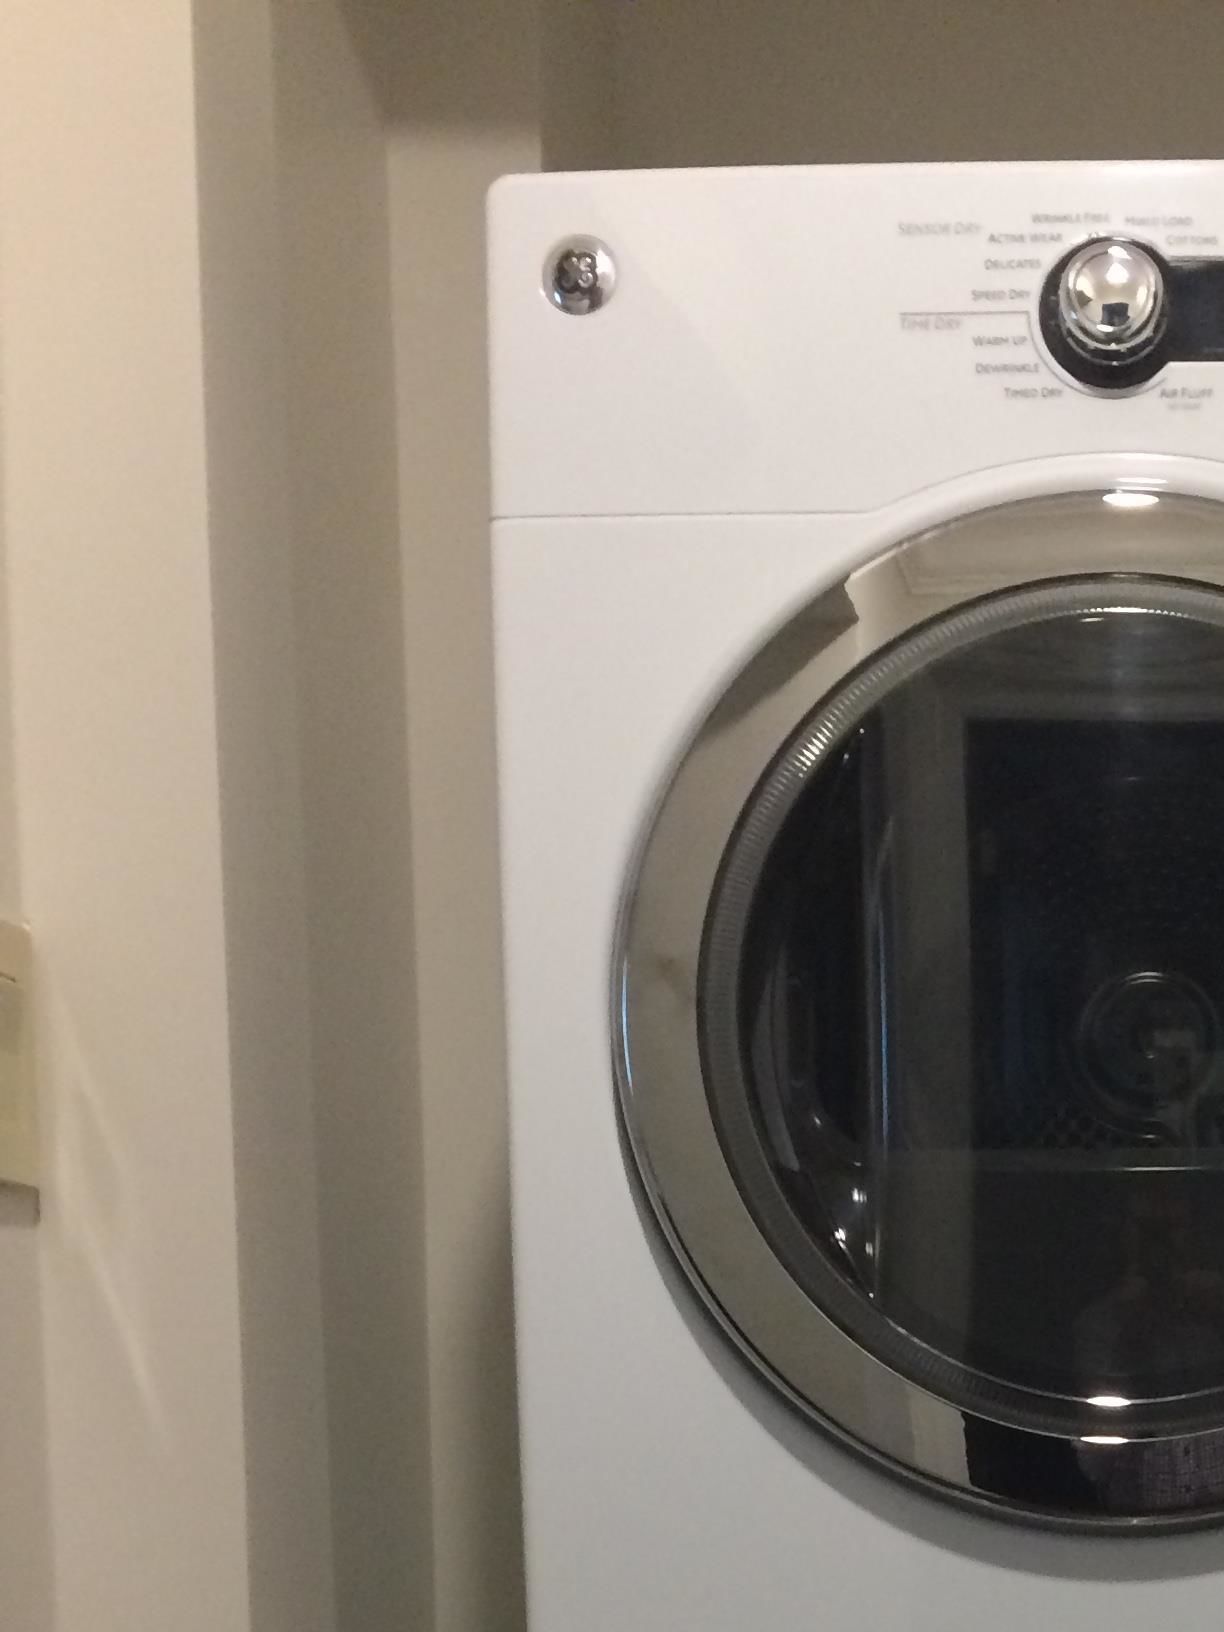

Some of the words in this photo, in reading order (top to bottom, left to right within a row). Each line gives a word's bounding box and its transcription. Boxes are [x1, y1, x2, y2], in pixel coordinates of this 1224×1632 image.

[954, 221, 982, 235] DRY
[984, 258, 1042, 270] DELICATES
[1009, 288, 1031, 300] DRY
[1013, 335, 1028, 346] UP
